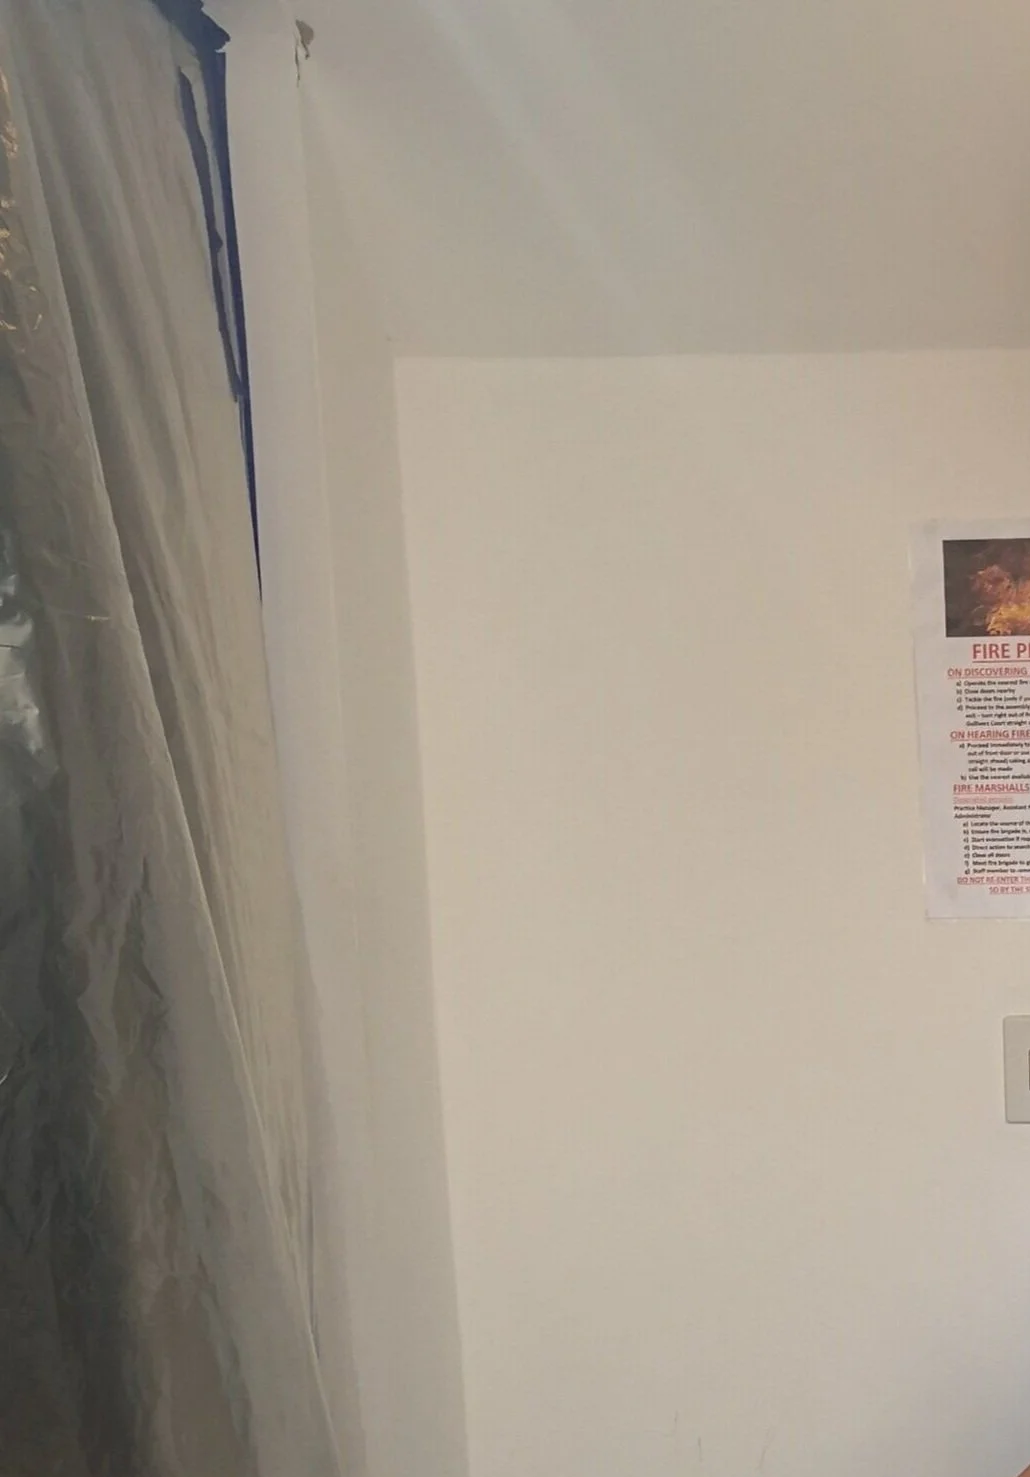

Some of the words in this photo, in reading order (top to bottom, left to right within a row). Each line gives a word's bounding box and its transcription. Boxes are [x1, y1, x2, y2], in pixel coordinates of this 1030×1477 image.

[971, 642, 1010, 660] FIRE
[947, 668, 962, 677] ON
[964, 667, 1028, 677] DISCOVERING
[950, 729, 965, 739] ON
[967, 728, 1009, 739] HEARING
[1011, 728, 1030, 738] FIRE
[953, 783, 973, 794] FIRE
[975, 783, 1030, 793] MARSHALLS
